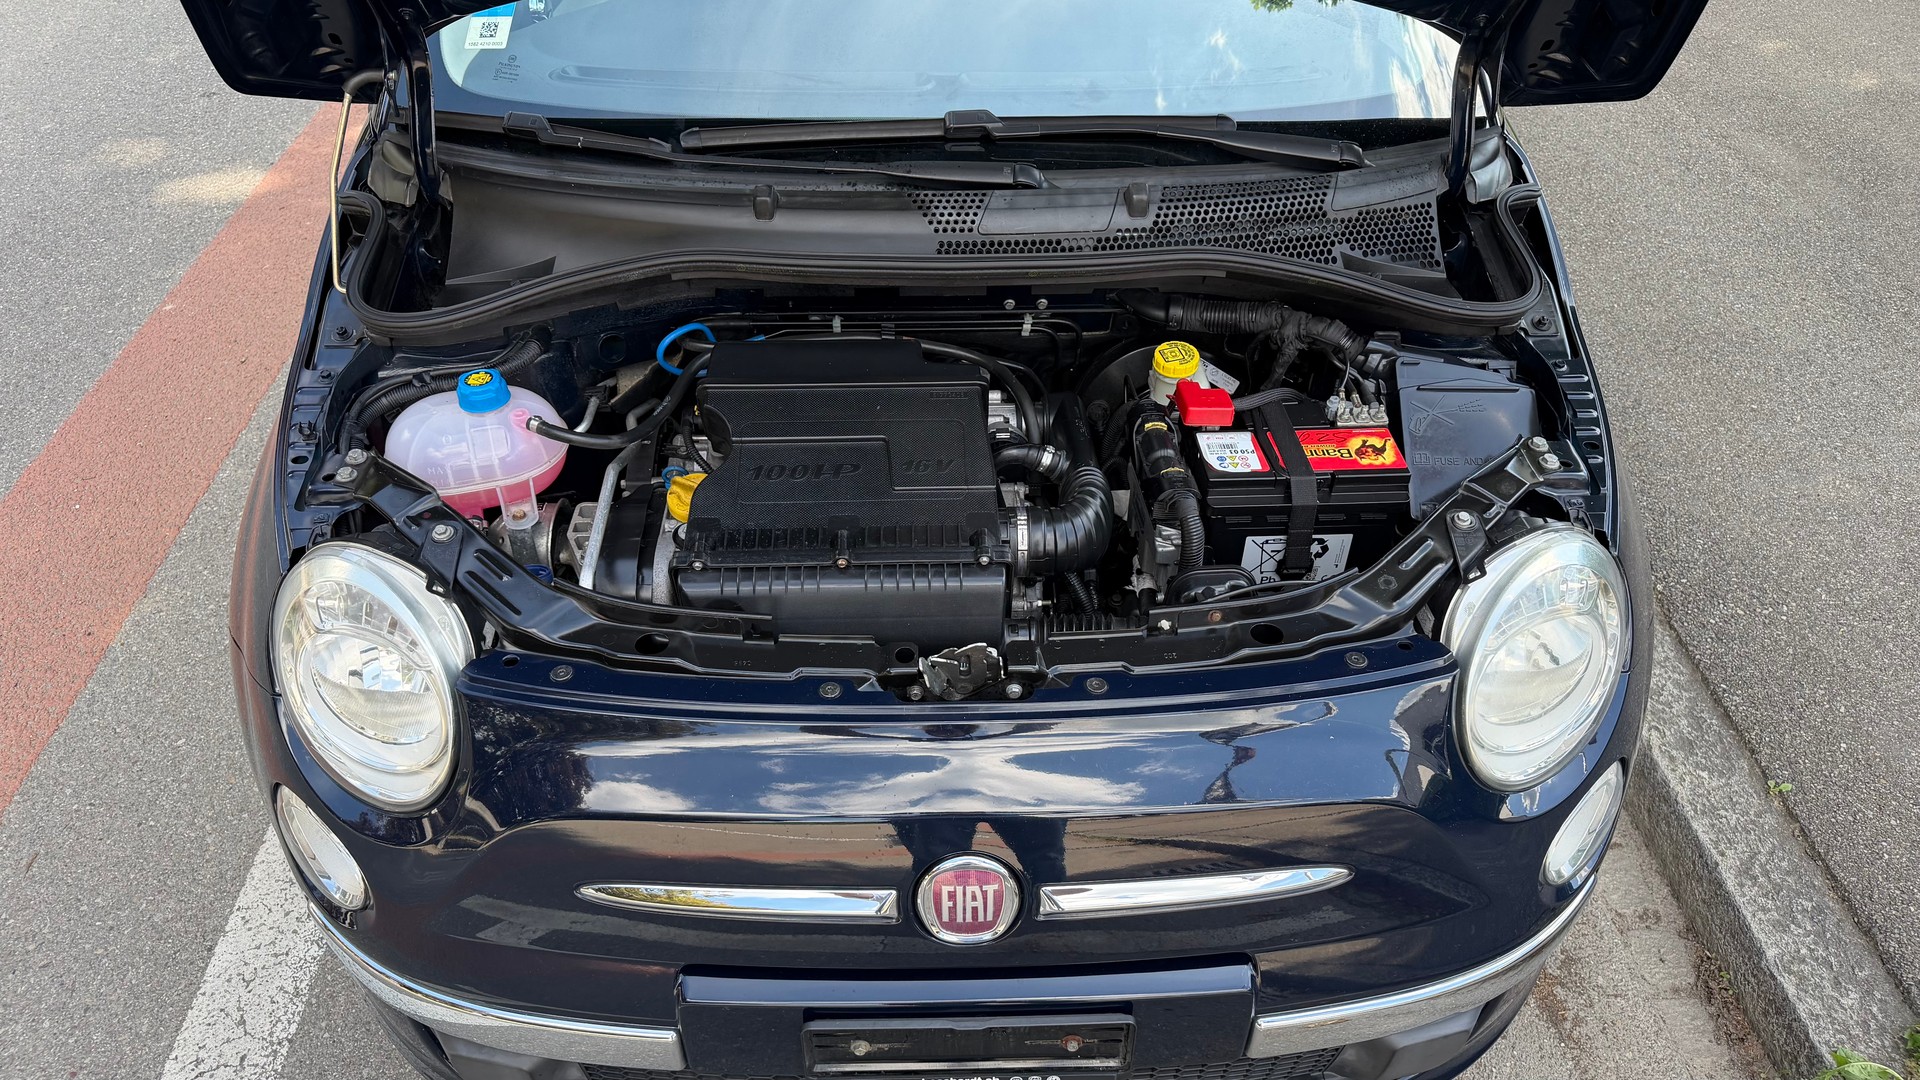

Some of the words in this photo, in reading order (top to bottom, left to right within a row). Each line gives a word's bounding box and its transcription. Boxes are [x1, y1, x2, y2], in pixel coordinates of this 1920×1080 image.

[1434, 457, 1460, 465] FUSE
[1463, 457, 1484, 465] AND
[1260, 576, 1276, 584] Pb
[941, 884, 999, 923] FIAT
